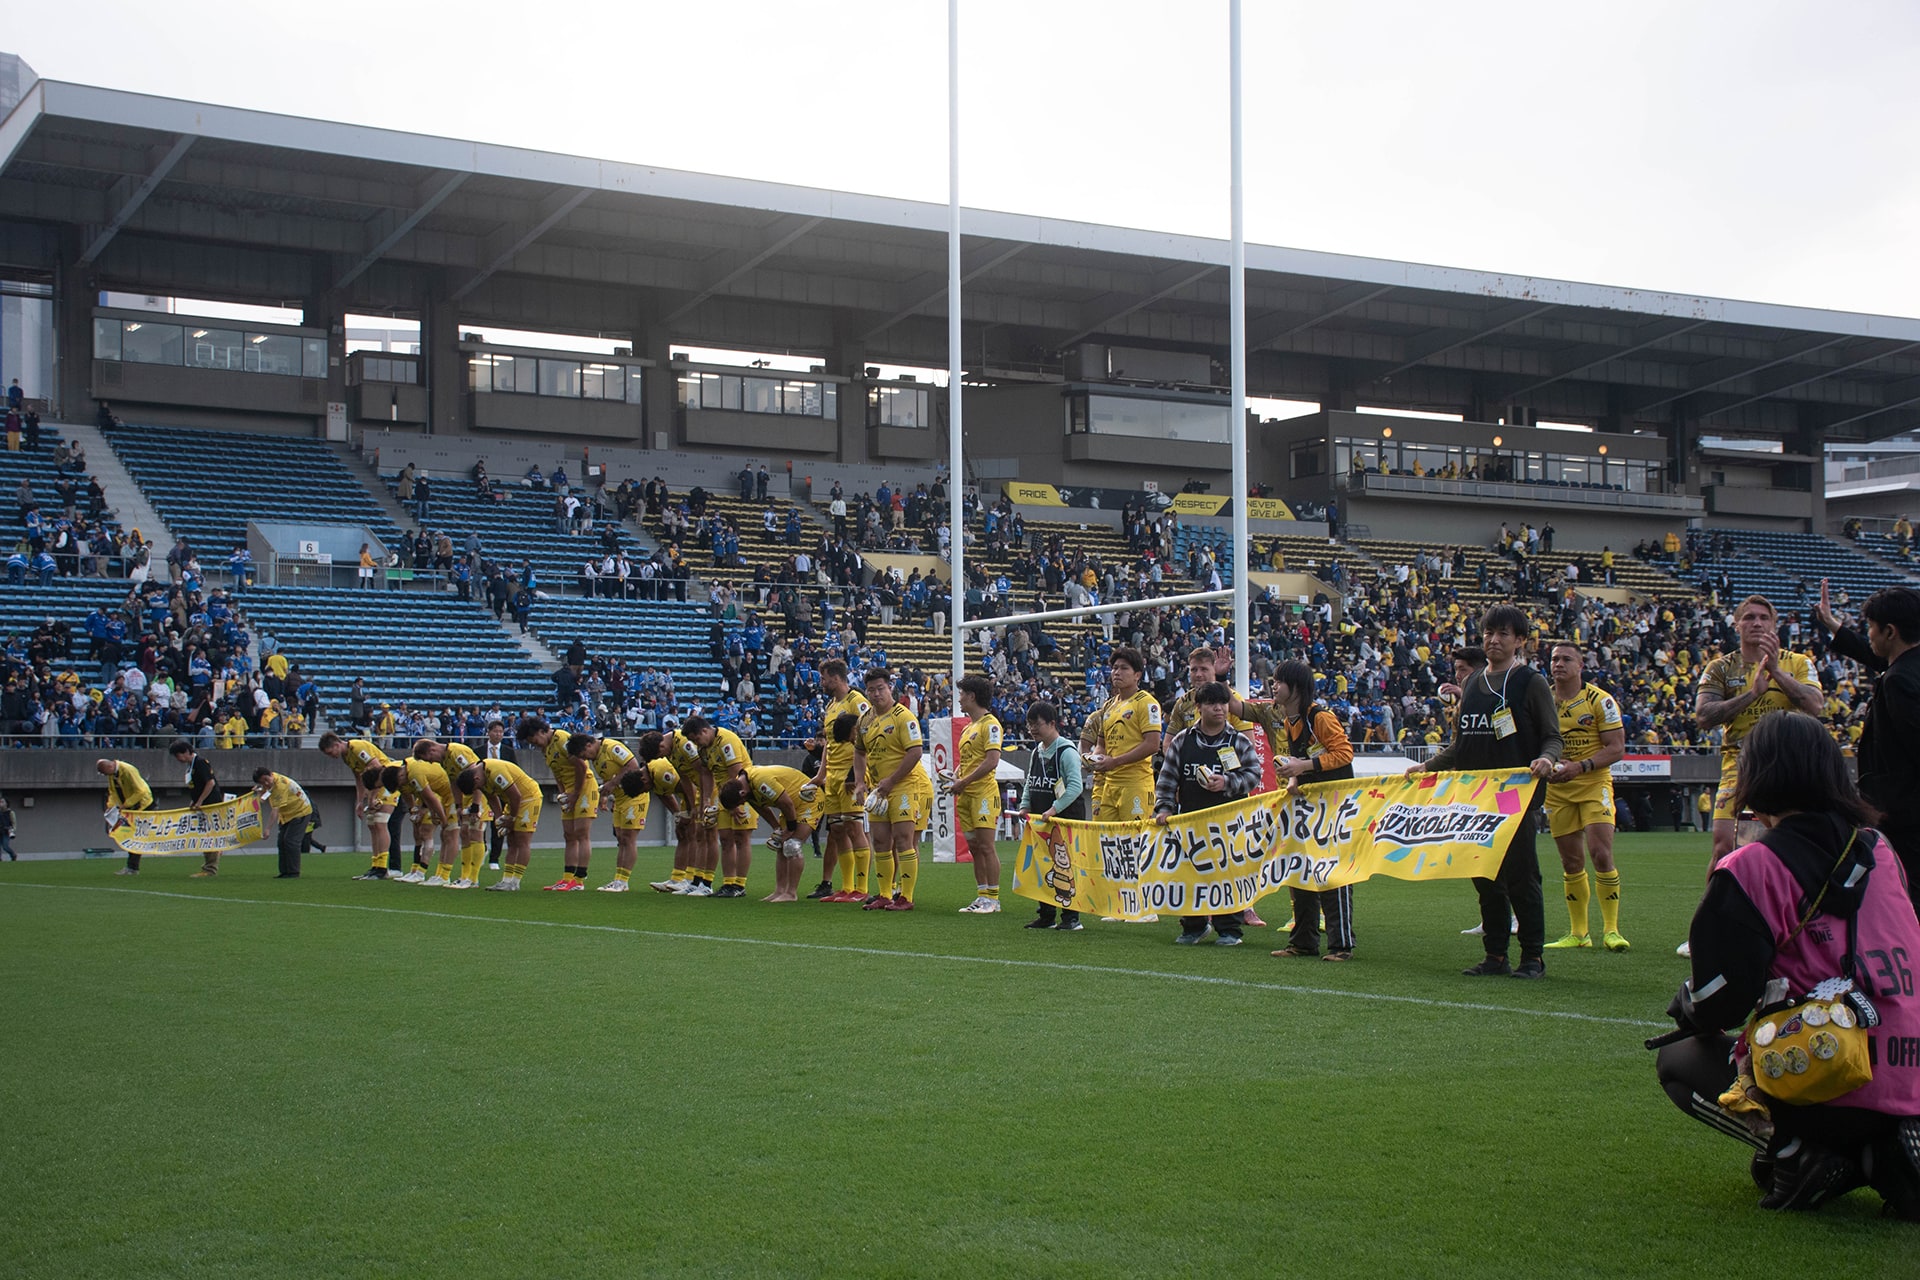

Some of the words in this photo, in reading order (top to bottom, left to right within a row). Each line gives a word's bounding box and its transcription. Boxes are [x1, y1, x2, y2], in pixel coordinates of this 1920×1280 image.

[1019, 489, 1047, 499] PRIDE
[1175, 499, 1218, 510] RESPECT
[1247, 500, 1276, 509] NEVER
[1251, 509, 1271, 517] GIVE
[1272, 510, 1285, 518] UP
[306, 543, 313, 552] 6
[1460, 713, 1494, 729] STA
[936, 779, 948, 838] MUFG
[1375, 812, 1507, 837] SUNGOLIATH
[1458, 832, 1489, 841] TOKYO
[188, 838, 197, 848] IN
[200, 837, 213, 848] THE
[1142, 884, 1184, 909] YOU
[1193, 883, 1233, 911] FOR
[1809, 929, 1834, 945] ONE
